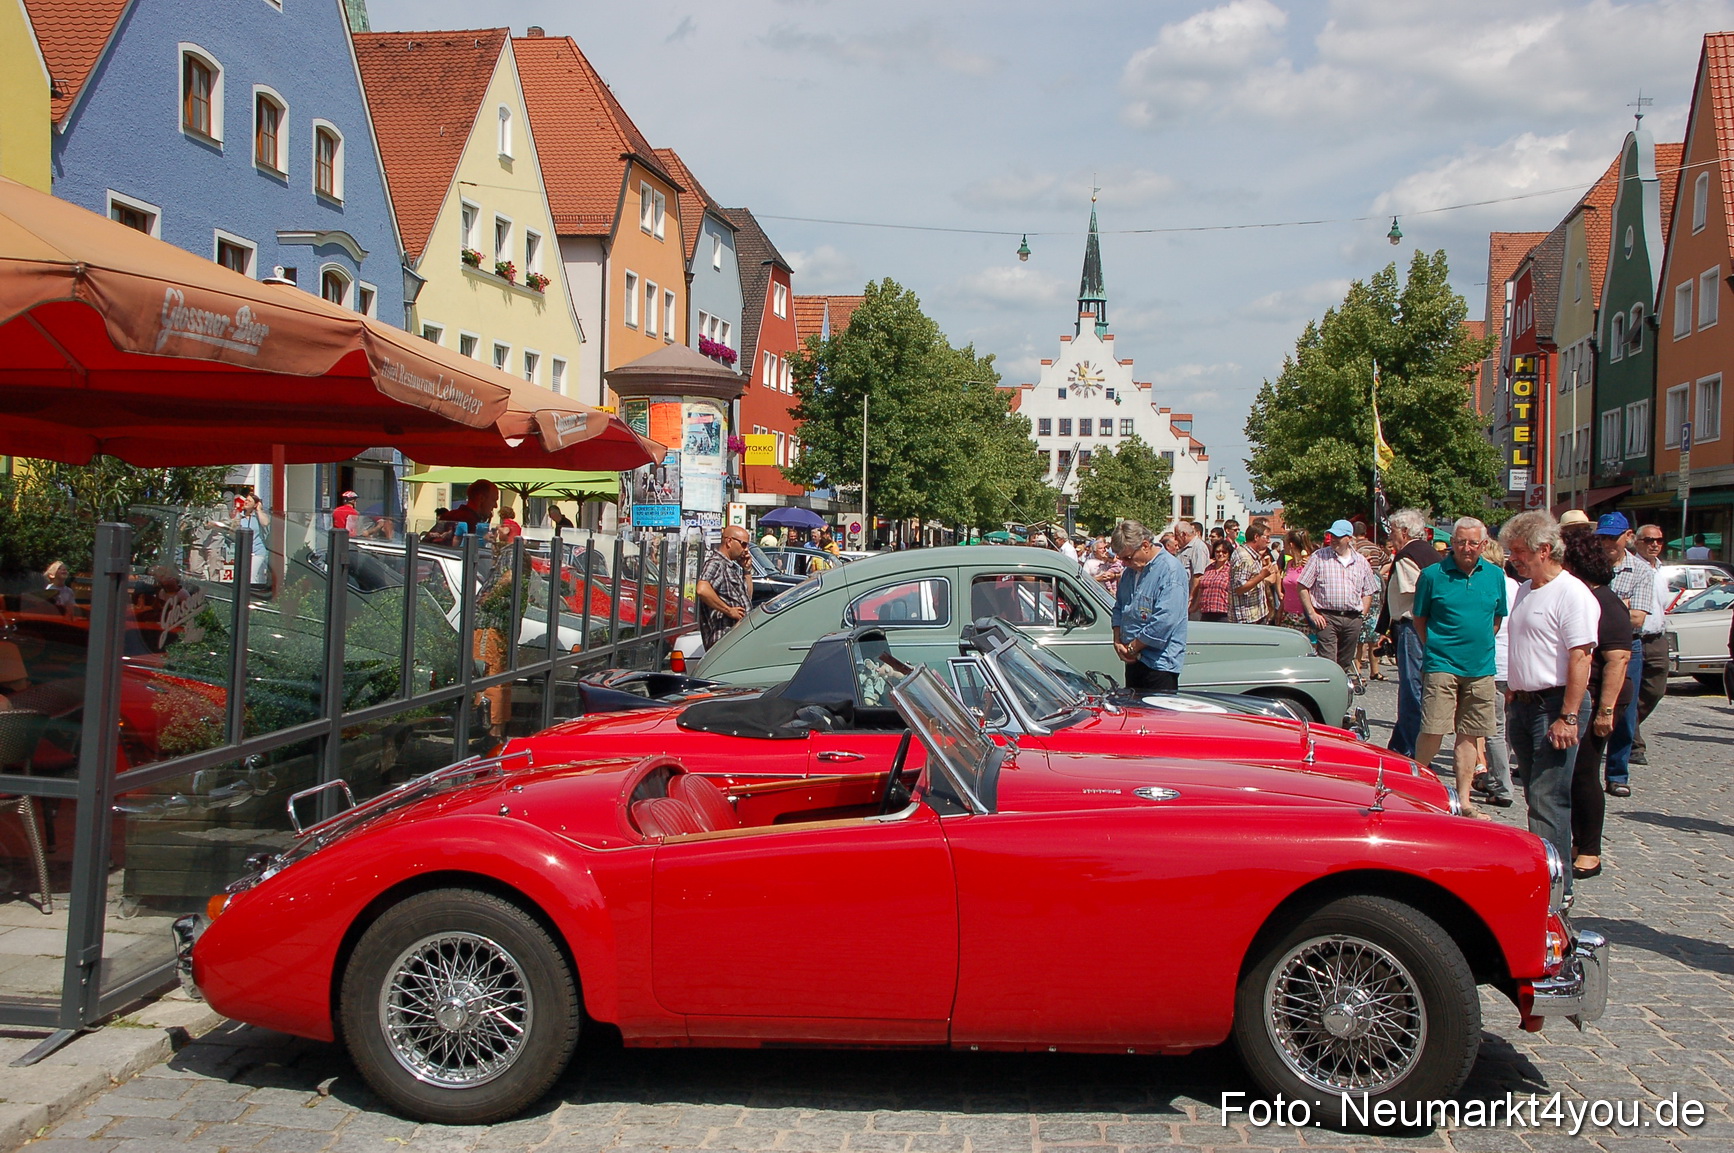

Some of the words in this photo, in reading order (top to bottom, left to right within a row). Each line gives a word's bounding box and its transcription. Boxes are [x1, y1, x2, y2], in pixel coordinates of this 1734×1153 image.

[436, 373, 484, 416] Lehmeier
[1512, 357, 1533, 465] HOTEL
[696, 512, 722, 520] THOMAS
